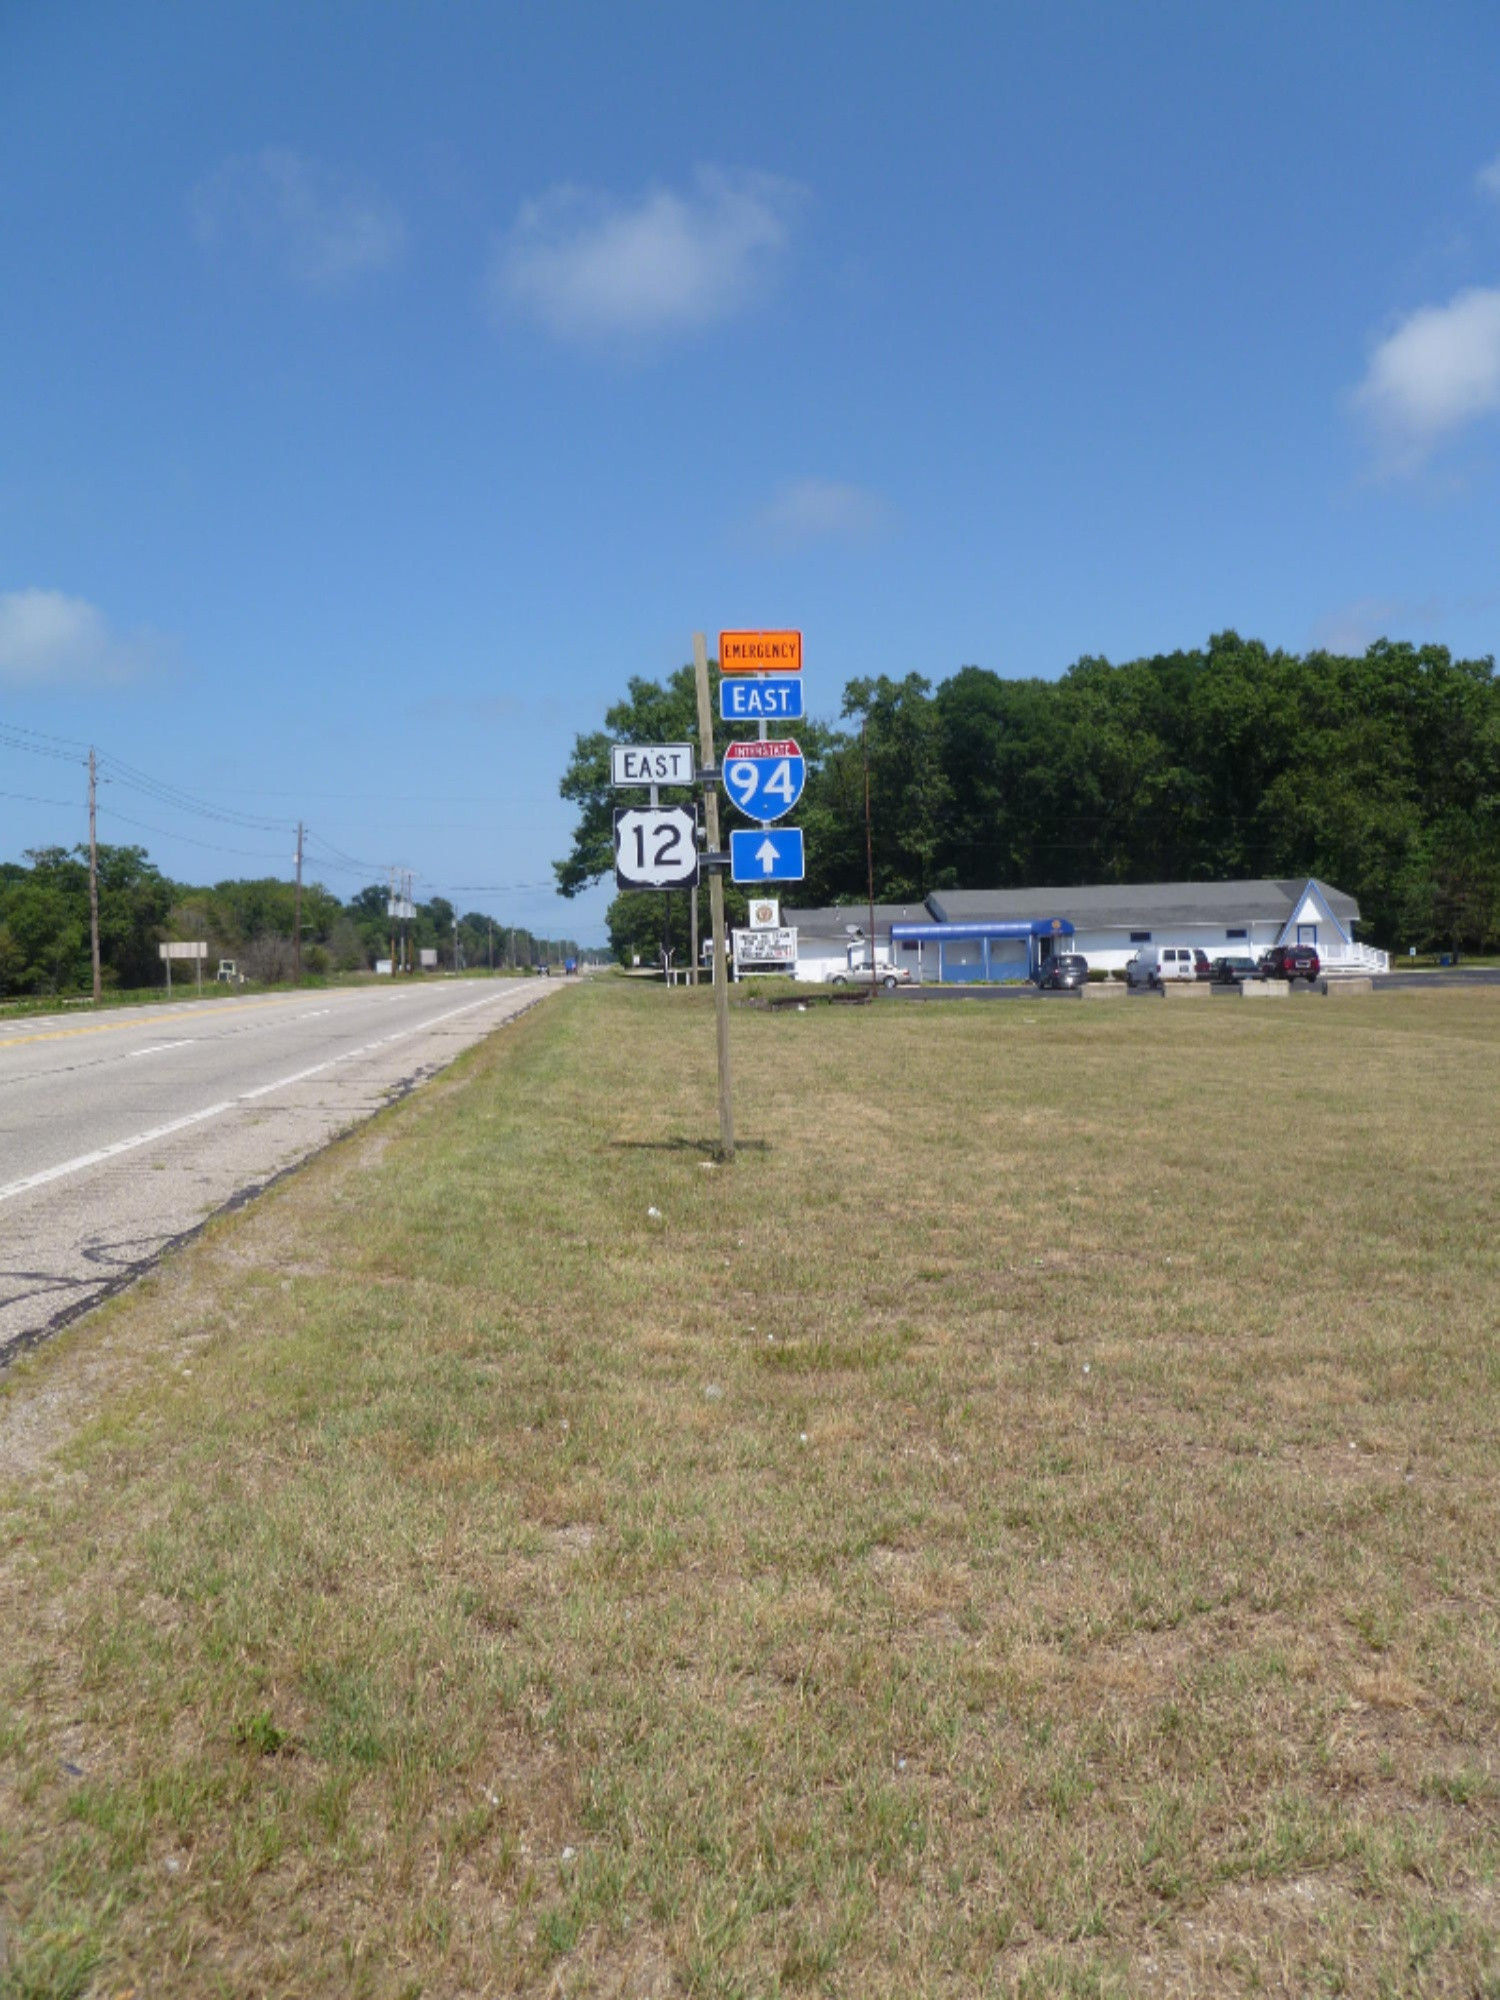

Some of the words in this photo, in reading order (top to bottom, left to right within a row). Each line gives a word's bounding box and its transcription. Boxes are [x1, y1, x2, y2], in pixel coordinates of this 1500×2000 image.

[724, 642, 797, 658] EMERGENCY
[733, 686, 791, 712] EAST
[624, 752, 681, 778] EAST
[730, 760, 795, 806] 94
[632, 824, 682, 868] 12
